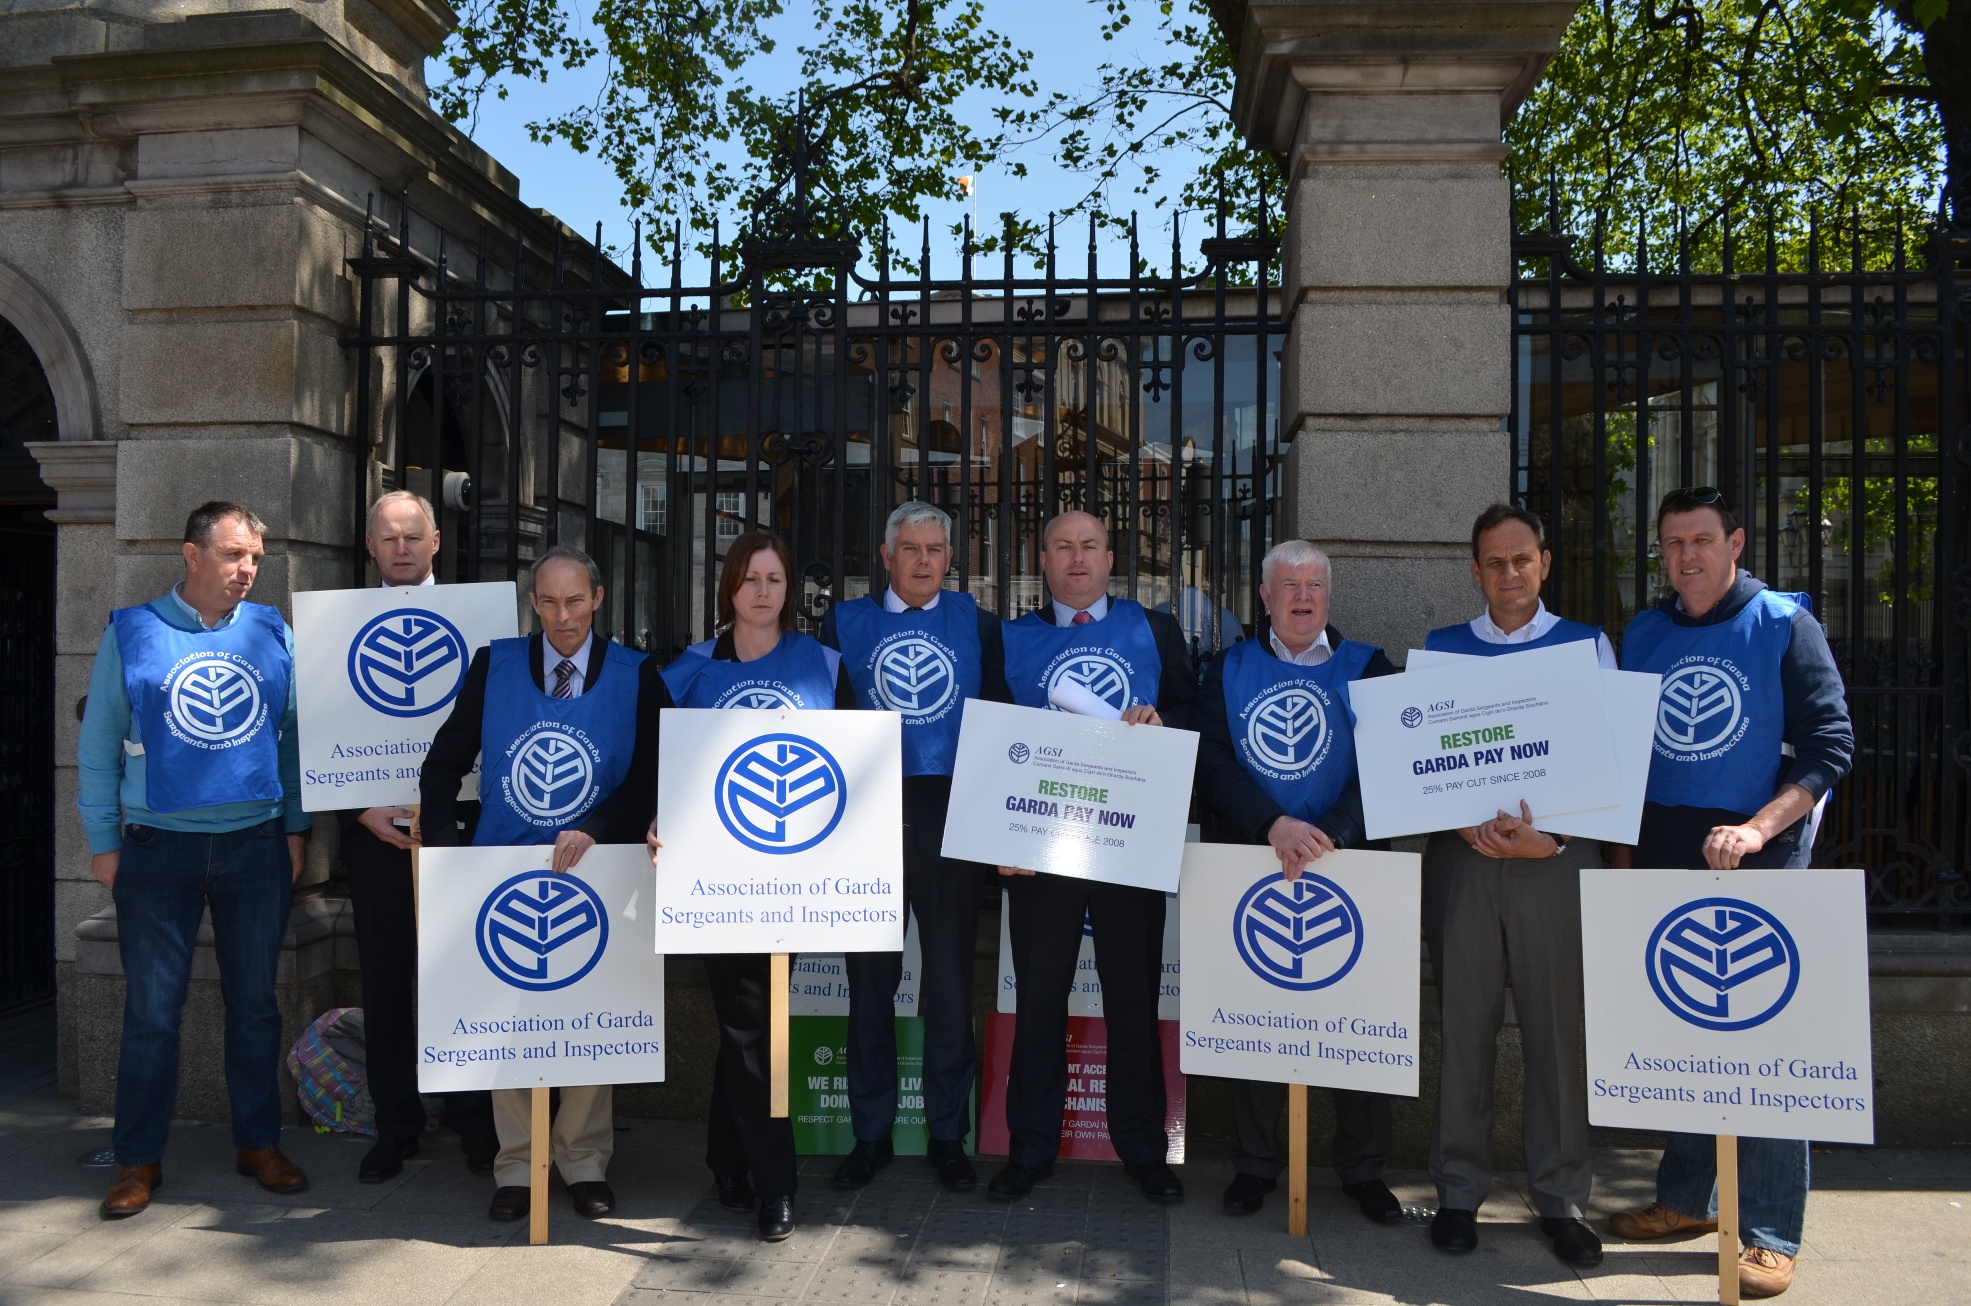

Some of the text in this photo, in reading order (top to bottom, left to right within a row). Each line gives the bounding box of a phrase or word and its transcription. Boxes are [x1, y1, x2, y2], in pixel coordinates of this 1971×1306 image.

[867, 630, 915, 670] Association
[931, 636, 957, 662] Garda
[161, 651, 264, 692] Association of Garda
[1038, 646, 1087, 688] Association
[1105, 648, 1134, 675] Garda
[1662, 655, 1750, 691] ciation of Garda
[712, 680, 754, 709] ociation
[772, 681, 804, 707] Garda
[1240, 679, 1331, 719] Association of Garda
[1427, 700, 1455, 712] AGSI
[164, 703, 268, 750] Sergeants and Inspectors
[1440, 724, 1515, 750] RESTORE
[1676, 753, 1698, 762] and
[1700, 717, 1749, 761] Inspectors
[505, 720, 601, 763] Association of Garda
[1035, 746, 1063, 757] AGSI
[1240, 729, 1333, 780] Sergeants and Inspectors
[1413, 740, 1549, 775] GARDA PAY NOW
[305, 767, 390, 787] Sergeants
[1423, 769, 1546, 794] 25% PAY CUT SINCE 2008
[502, 776, 532, 822] Sergeants
[555, 785, 600, 826] Inspectors
[1038, 780, 1108, 804] RESTORE
[1006, 796, 1136, 829] GARDA PAY NOW
[1009, 823, 1028, 833] 25%
[1031, 826, 1048, 836] PAY
[1103, 837, 1125, 848] 2008
[690, 877, 892, 896] Association of Garda
[662, 906, 897, 928] Sergeants and Inspectors
[804, 983, 831, 997] and
[453, 1010, 654, 1035] Association of Garda
[1212, 1008, 1408, 1040] Association of Garda
[424, 1040, 659, 1067] Sergeants and Inspectors
[1186, 1030, 1413, 1067] Sergeants and Inspectors
[1083, 1064, 1106, 1074] ACCE
[1624, 1052, 1858, 1081] Association of Garda
[808, 1077, 848, 1090] WE RI
[901, 1078, 923, 1090] LIV
[1594, 1078, 1865, 1112] Sergeants and Inspectors
